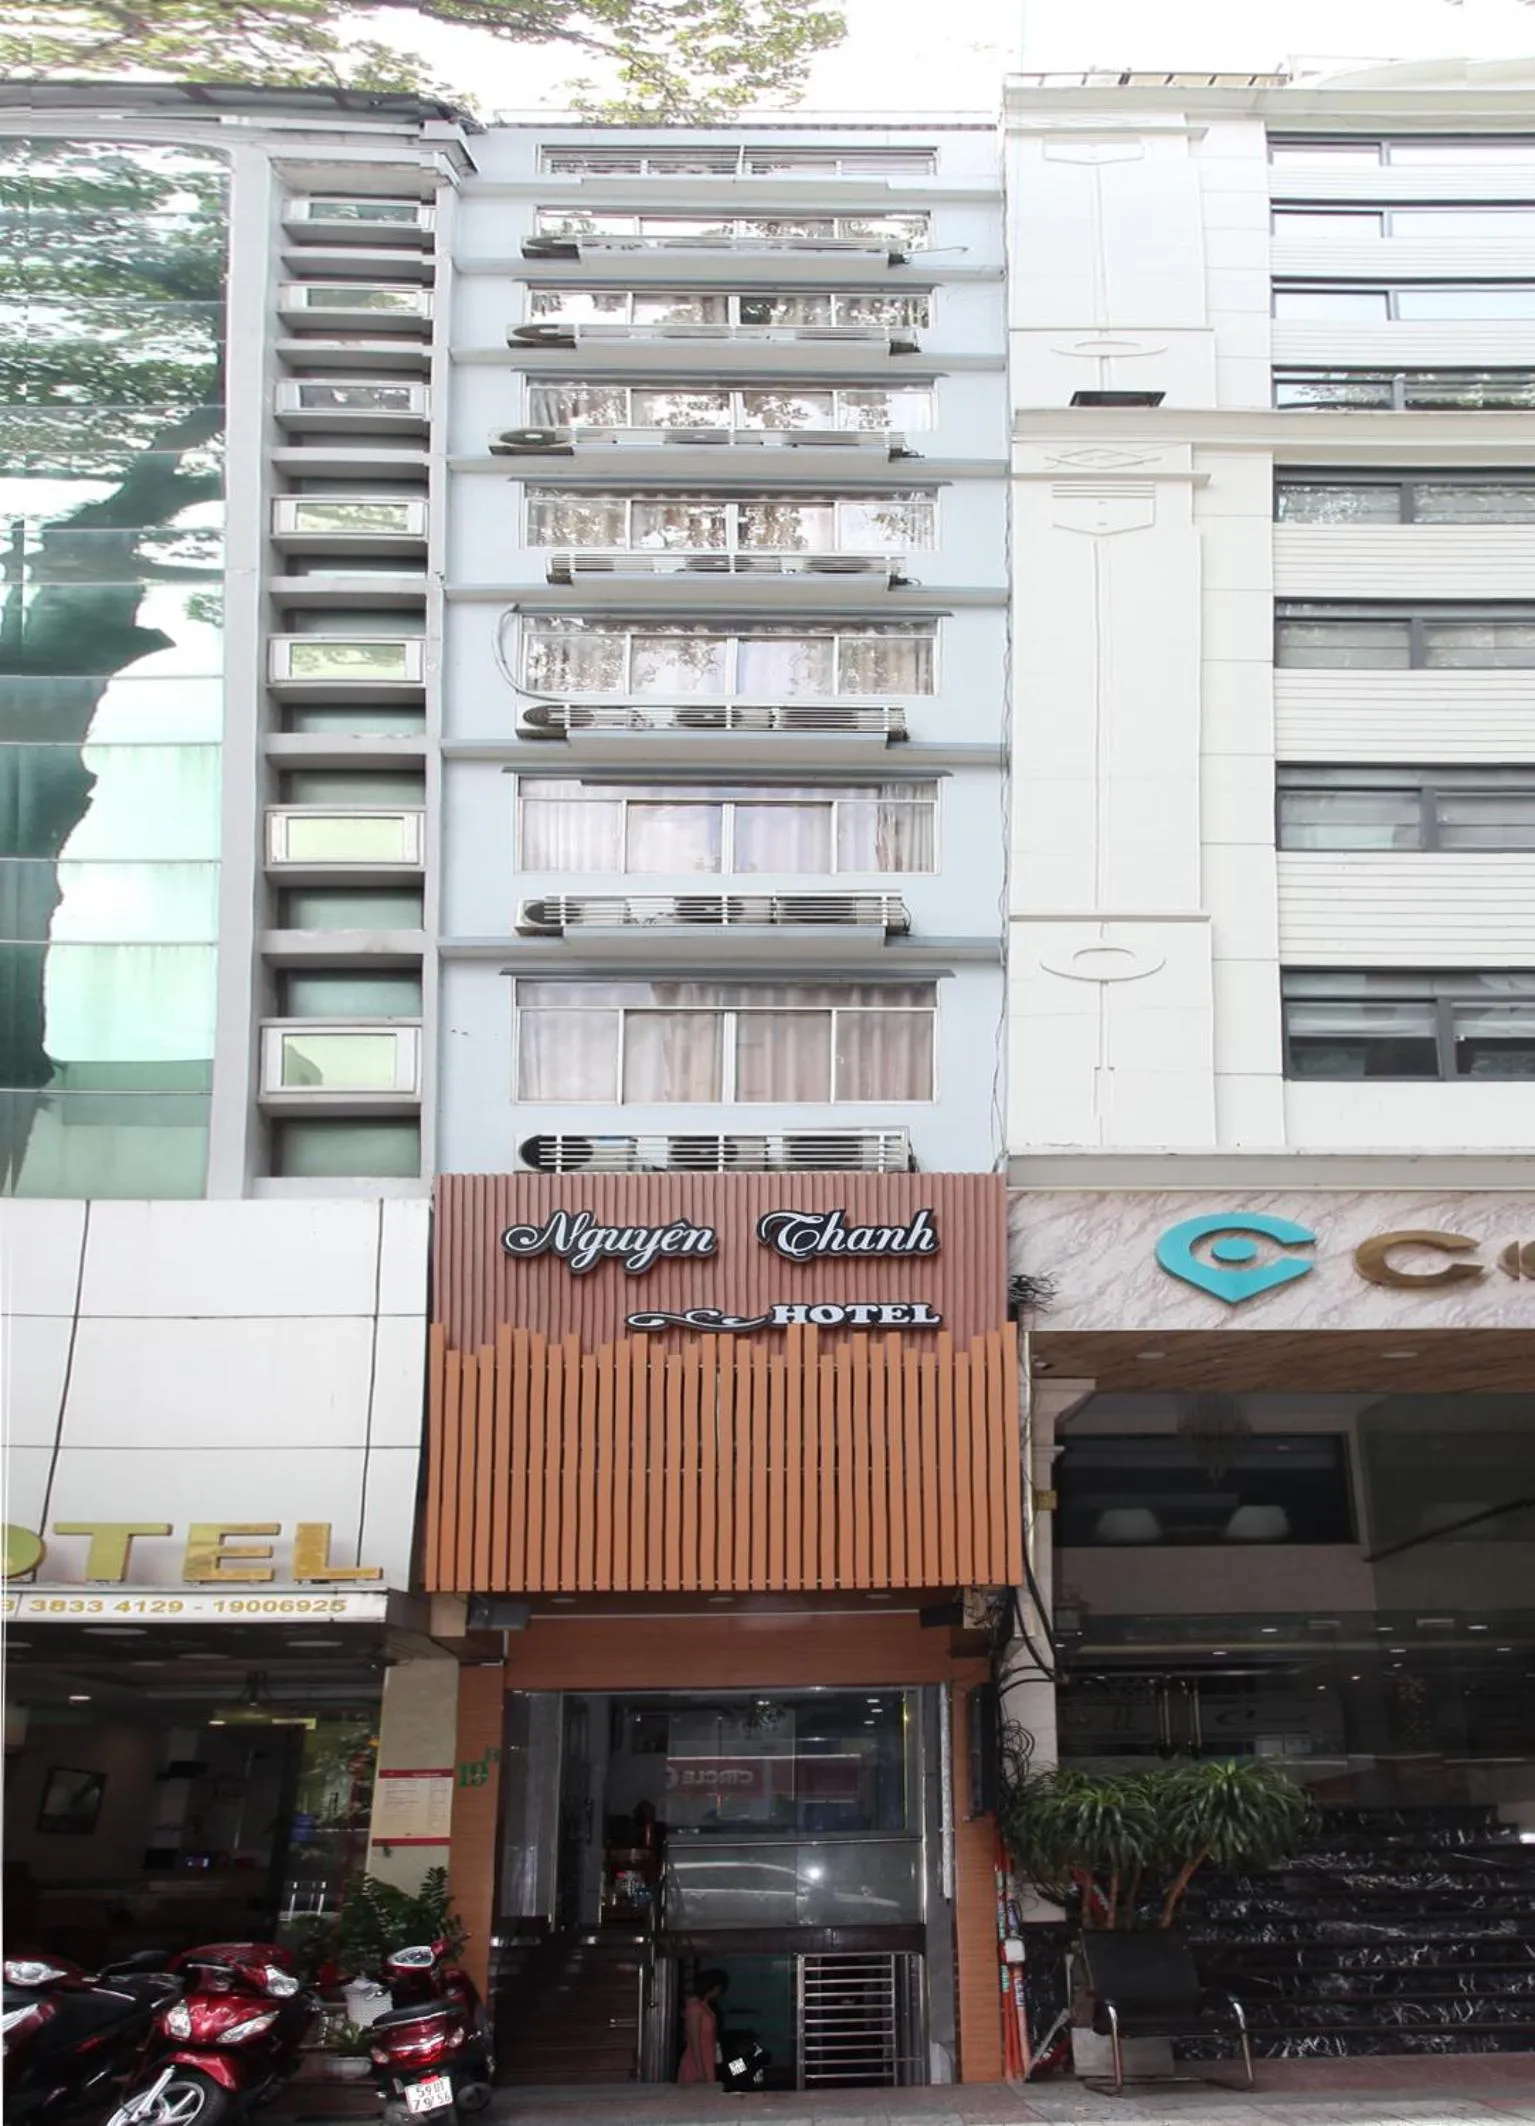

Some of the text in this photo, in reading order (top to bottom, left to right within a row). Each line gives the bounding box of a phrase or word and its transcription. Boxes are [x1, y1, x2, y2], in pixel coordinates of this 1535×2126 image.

[758, 1208, 940, 1261] Thanh
[771, 1303, 942, 1327] HOTEL
[29, 1599, 103, 1613] 3833
[113, 1599, 184, 1613] 4129
[213, 1599, 347, 1613] 19006925
